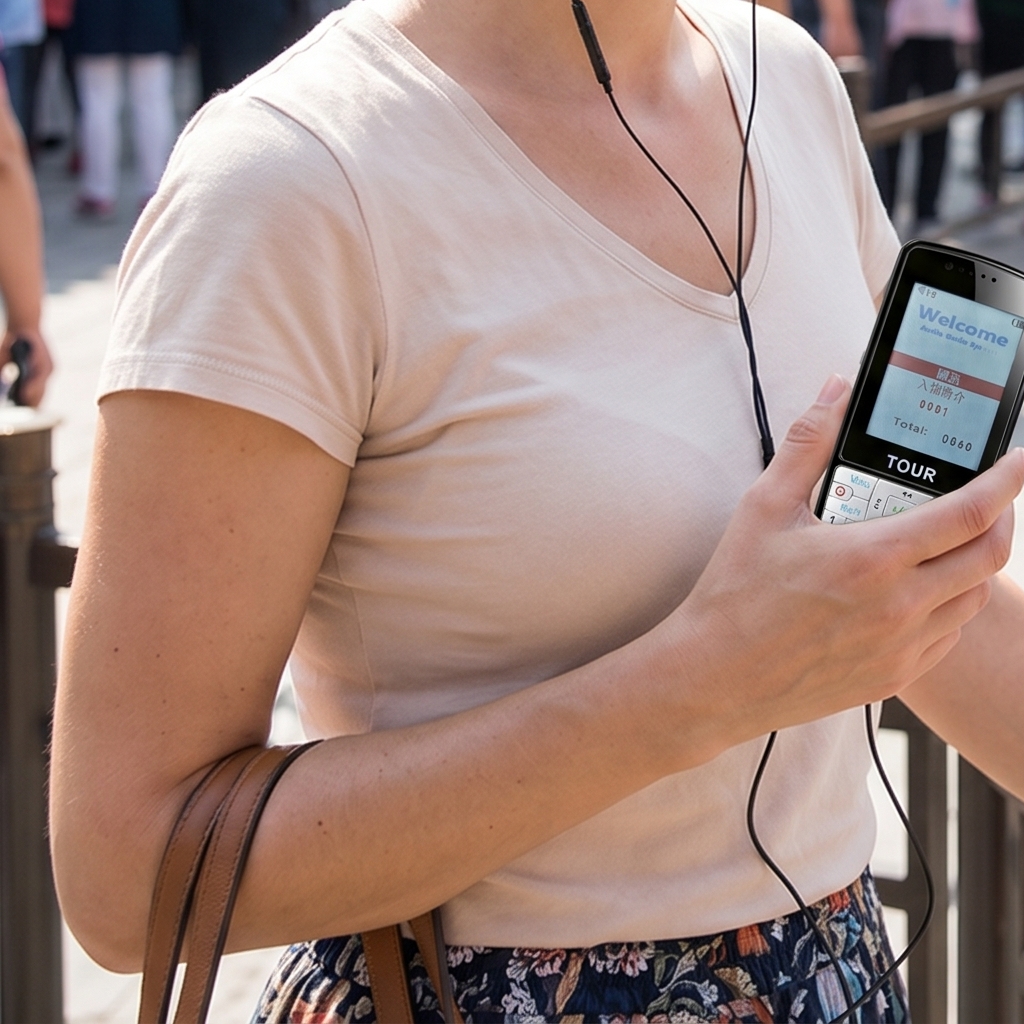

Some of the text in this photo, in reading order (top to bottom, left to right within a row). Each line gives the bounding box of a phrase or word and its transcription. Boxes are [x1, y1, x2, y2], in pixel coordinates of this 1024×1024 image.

[919, 304, 1009, 347] Welcome
[893, 417, 928, 436] Total:
[887, 454, 937, 483] TOUR
